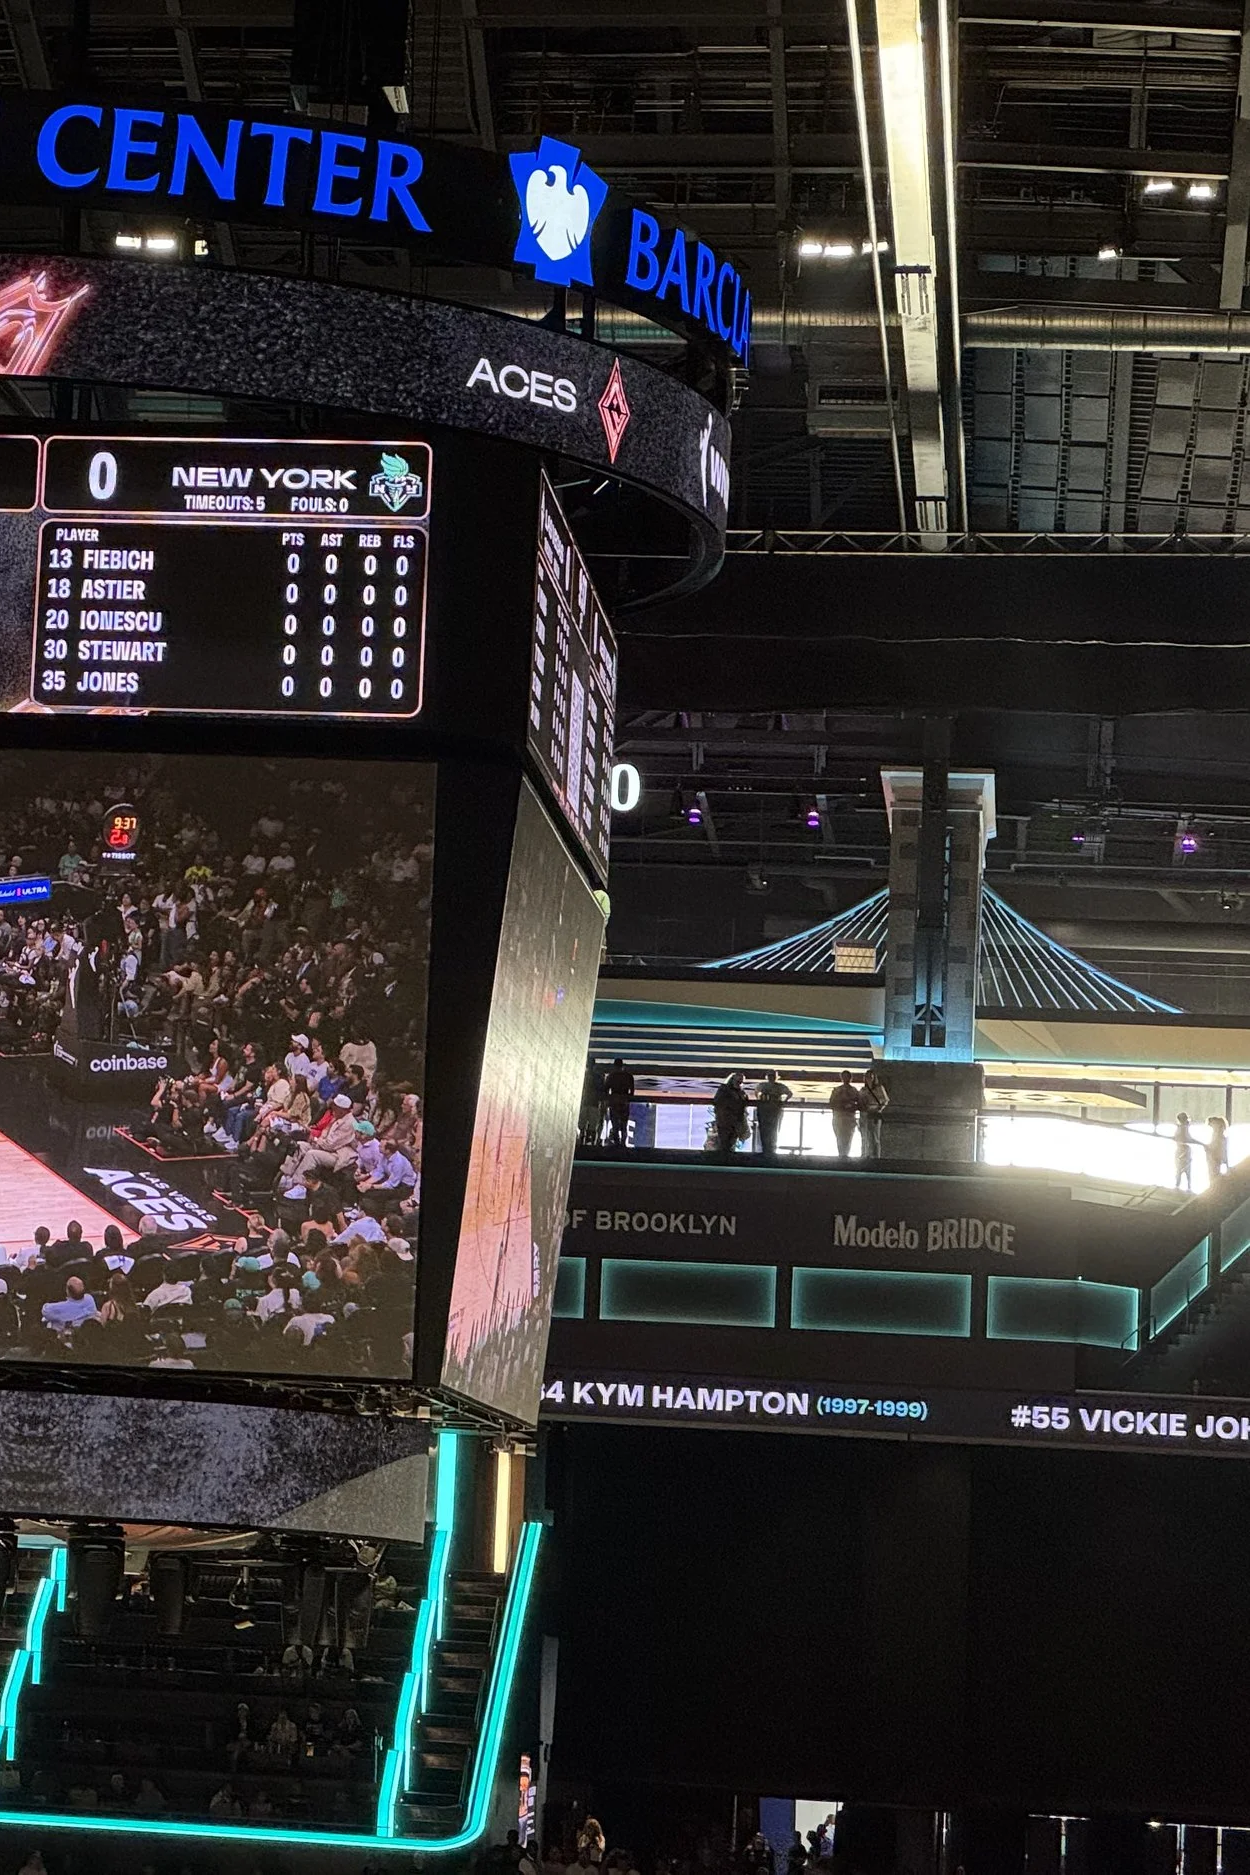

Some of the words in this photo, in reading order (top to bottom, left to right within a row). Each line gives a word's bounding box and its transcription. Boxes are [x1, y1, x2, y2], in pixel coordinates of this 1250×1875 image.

[36, 104, 432, 233] CENTER
[466, 358, 576, 412] ACES
[89, 452, 117, 499] 0
[172, 467, 253, 487] NEW
[260, 468, 356, 489] YORK
[184, 495, 254, 510] TIMEOUTS:
[256, 496, 265, 511] 5
[291, 497, 337, 512] FOULS:
[339, 498, 348, 512] 0
[56, 528, 98, 541] PLAYER
[282, 533, 304, 546] PTS
[321, 534, 343, 546] AST
[359, 534, 381, 547] REB
[394, 535, 414, 548] FLS
[49, 548, 72, 568] 13
[83, 550, 153, 570] FIEBICH
[288, 554, 299, 573] 0
[326, 554, 337, 574] 0
[365, 555, 376, 575] 0
[396, 556, 408, 575] 0
[48, 578, 70, 598] 18
[81, 579, 145, 600] ASTIER
[286, 584, 298, 603] 0
[324, 584, 336, 604] 0
[363, 585, 375, 605] 0
[395, 586, 407, 605] 0
[46, 609, 69, 629] 20
[80, 610, 161, 632] IONESCU
[285, 615, 296, 634] 0
[323, 616, 334, 635] 0
[362, 616, 373, 636] 0
[394, 617, 405, 637] 0
[44, 639, 67, 659] 30
[78, 640, 166, 661] STEWART
[283, 645, 295, 664] 0
[321, 645, 333, 666] 0
[361, 647, 372, 667] 0
[392, 647, 404, 667] 0
[42, 670, 65, 690] 35
[77, 672, 139, 693] JONES
[282, 676, 294, 696] 0
[320, 677, 332, 697] 0
[359, 678, 371, 698] 0
[391, 679, 403, 699] 0
[90, 1054, 167, 1071] coinbase
[83, 1167, 208, 1231] ACES
[168, 1190, 218, 1222] VEGAS
[595, 1210, 737, 1236] BROOKLYN
[834, 1214, 919, 1250] Modelo
[927, 1217, 1016, 1256] BRIDGE
[573, 1382, 644, 1406] KYM
[653, 1386, 808, 1415] HAMPTON
[817, 1396, 927, 1420] (1997-1999)
[1011, 1405, 1070, 1429] #55
[1079, 1409, 1186, 1436] VICKIE
